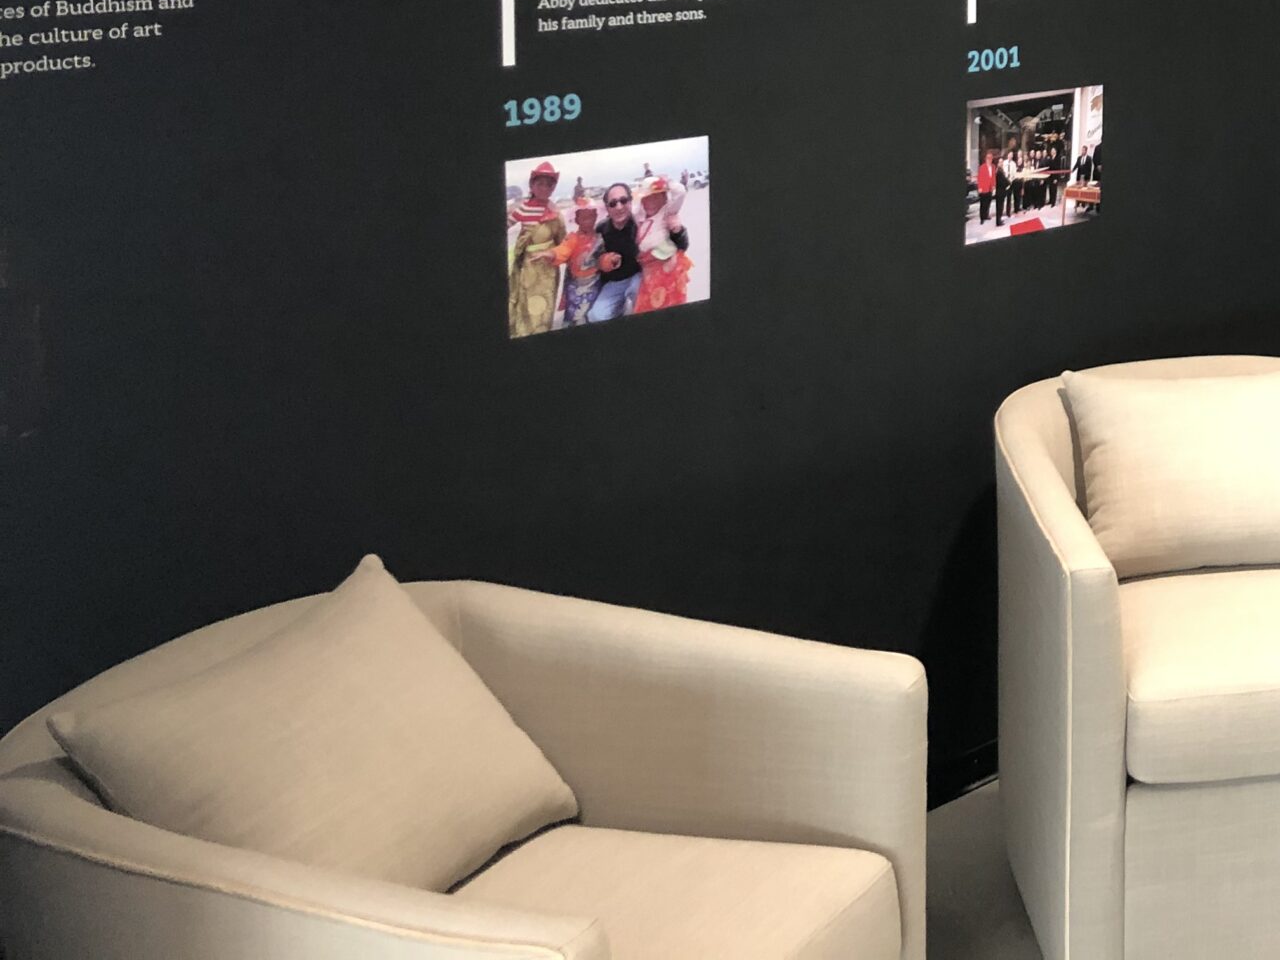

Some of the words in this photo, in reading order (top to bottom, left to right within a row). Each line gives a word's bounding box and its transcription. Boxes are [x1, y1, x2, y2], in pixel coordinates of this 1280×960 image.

[30, 1, 50, 17] of
[538, 18, 558, 31] his
[561, 14, 605, 30] family
[608, 12, 634, 26] and
[636, 10, 672, 24] three
[675, 9, 706, 21] sons.
[29, 27, 102, 44] culture
[108, 22, 128, 39] of
[133, 23, 161, 37] art
[0, 55, 95, 79] products.
[967, 46, 1020, 73] 2001
[503, 92, 582, 128] 1989
